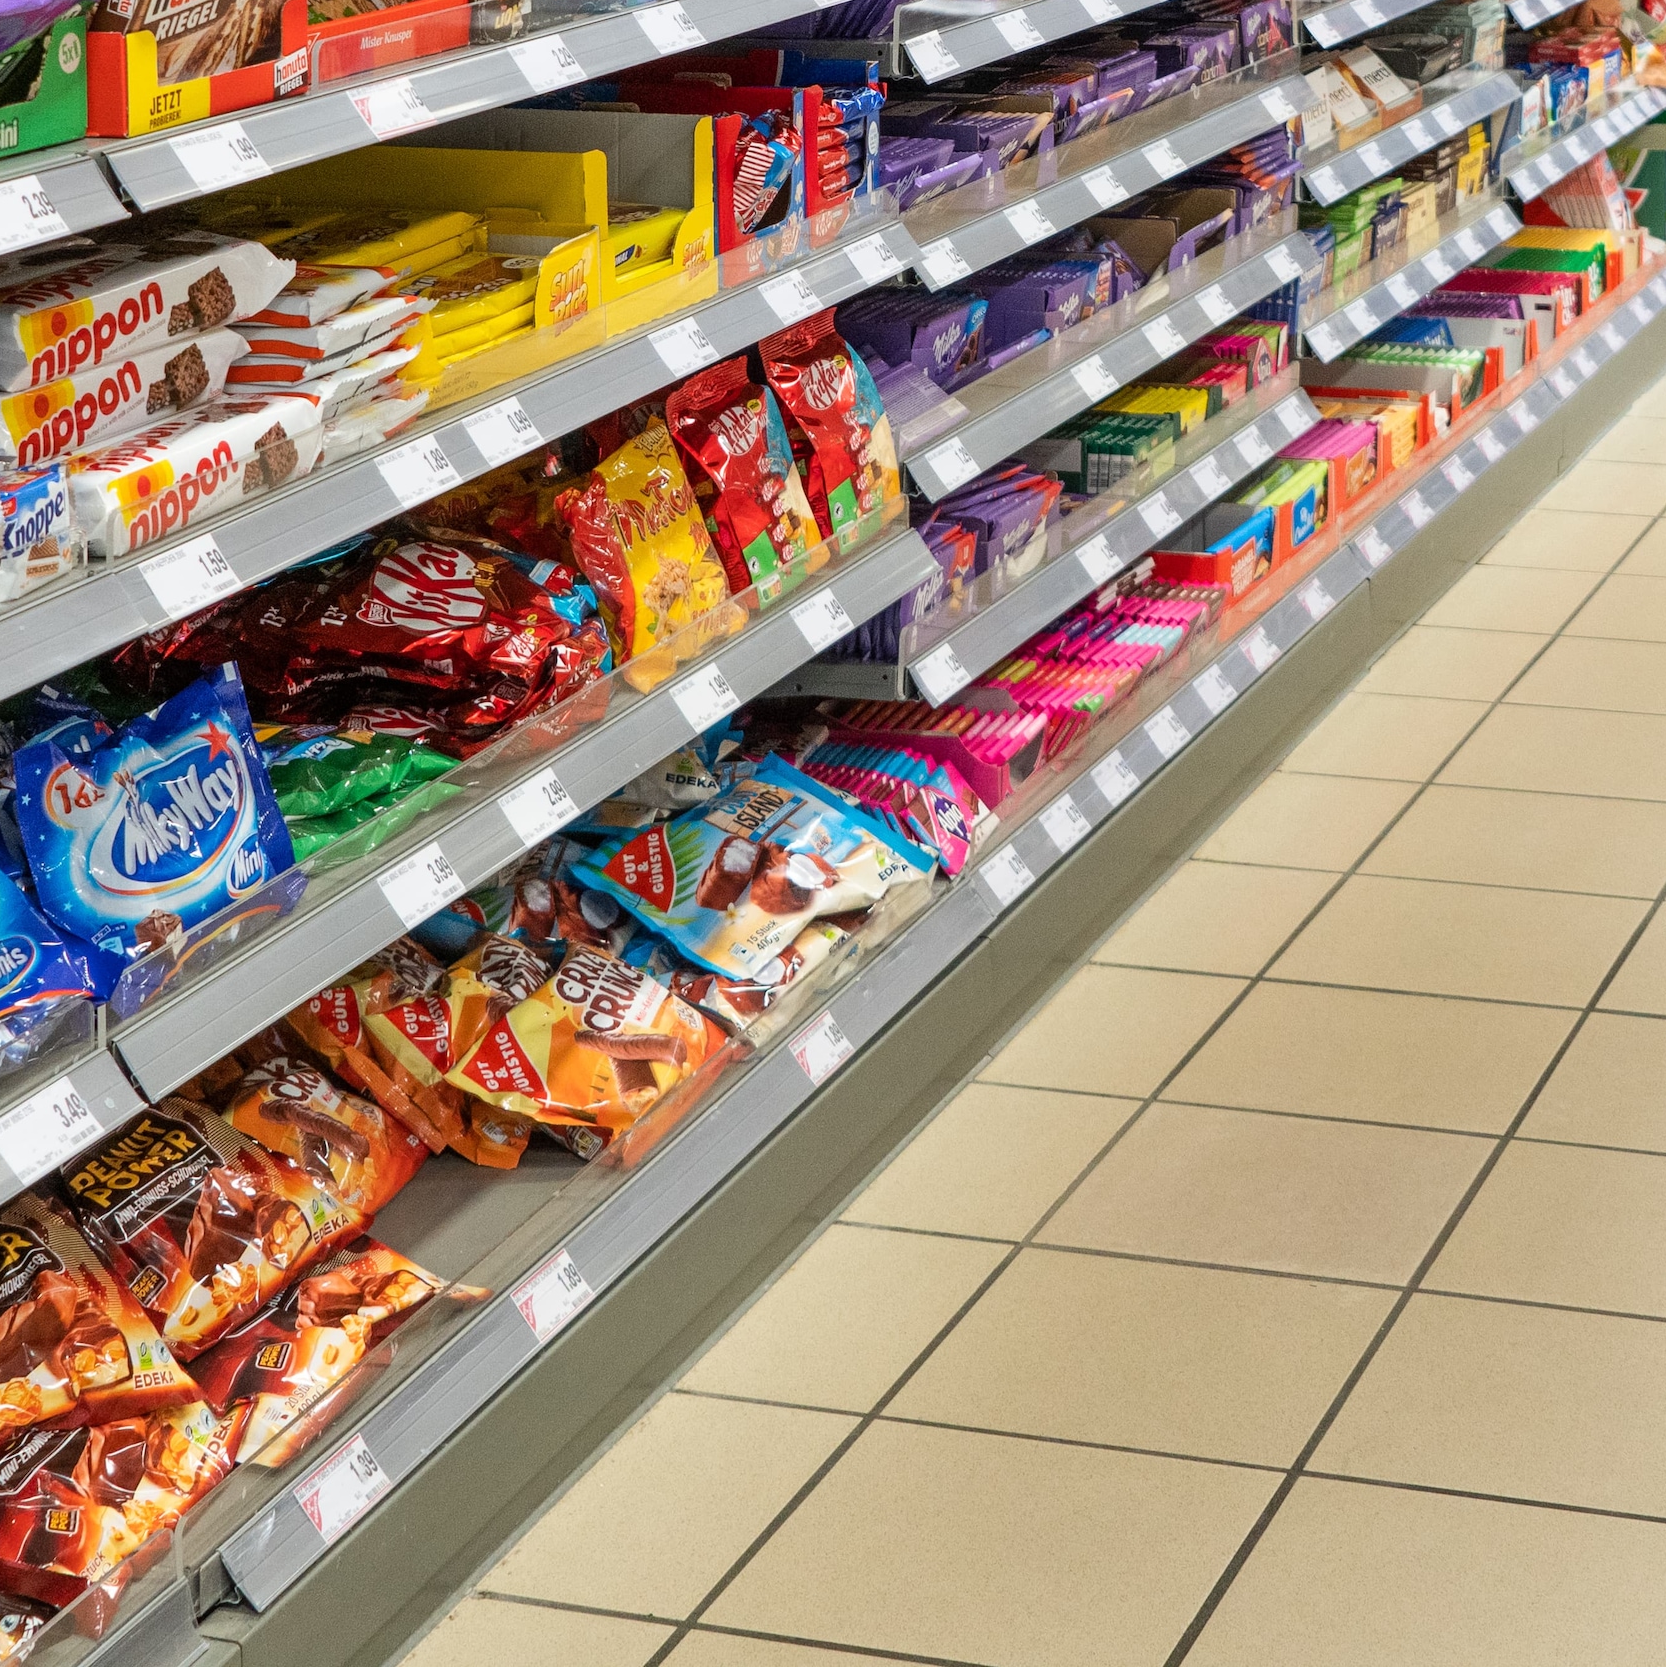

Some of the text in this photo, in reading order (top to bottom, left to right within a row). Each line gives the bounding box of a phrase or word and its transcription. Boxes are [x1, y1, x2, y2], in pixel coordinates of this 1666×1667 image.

[157, 0, 220, 42] RIEGEL
[360, 29, 413, 50] Mister Knusper
[274, 49, 307, 87] hanuta
[1363, 64, 1391, 86] merci
[279, 77, 304, 96] RIEGEL
[150, 90, 184, 117] JETZT
[229, 138, 255, 163] 1.99
[22, 192, 52, 219] 2.39
[31, 281, 164, 385] nippon
[19, 360, 141, 468] nippon
[507, 402, 534, 435] 0.99
[424, 449, 449, 472] 1.89
[130, 438, 239, 550] nippon
[199, 548, 229, 577] 1.59
[545, 780, 567, 808] 2.99
[665, 772, 718, 790] EDEKA
[122, 756, 239, 875] MilkyWay
[428, 855, 452, 884] 3.99
[52, 1091, 84, 1126] 3.49
[69, 1120, 172, 1197] PEANUT
[312, 1214, 351, 1244] EDEKA
[134, 1370, 176, 1389] EDEKA
[348, 1448, 377, 1478] 1.39
